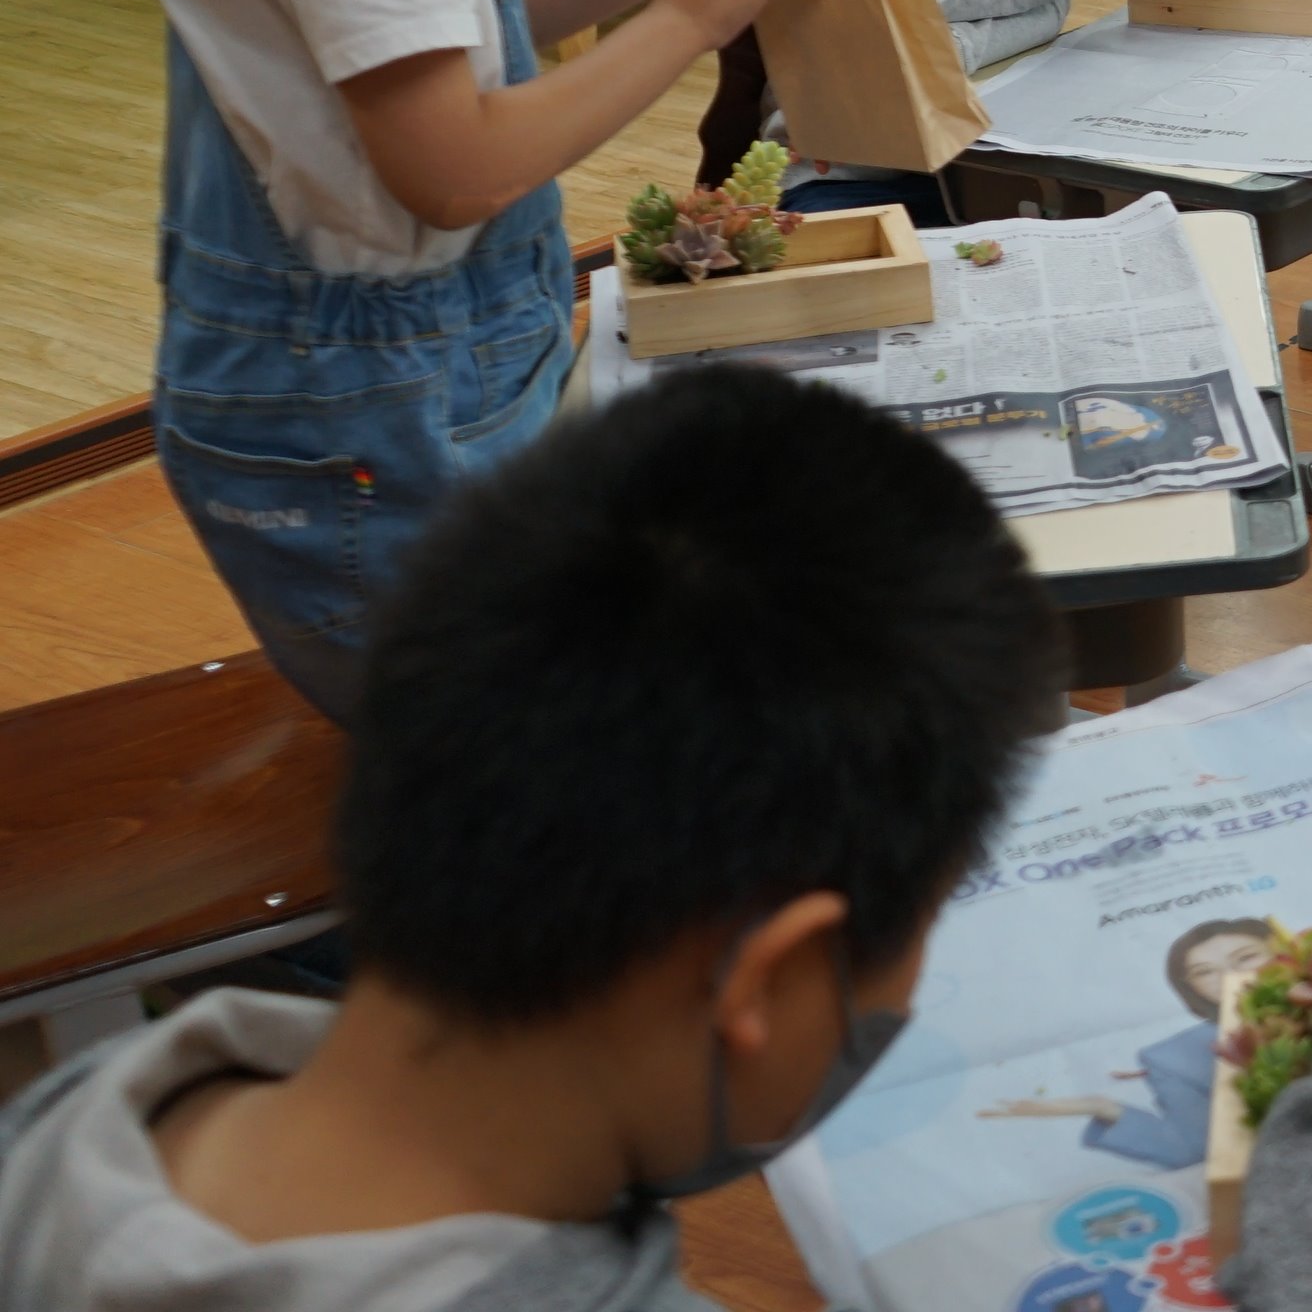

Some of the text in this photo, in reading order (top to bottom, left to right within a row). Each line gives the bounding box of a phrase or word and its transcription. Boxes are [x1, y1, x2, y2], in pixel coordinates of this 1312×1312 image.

[1018, 848, 1104, 885] One
[1109, 823, 1204, 860] Pack
[1098, 879, 1244, 928] Amaranth
